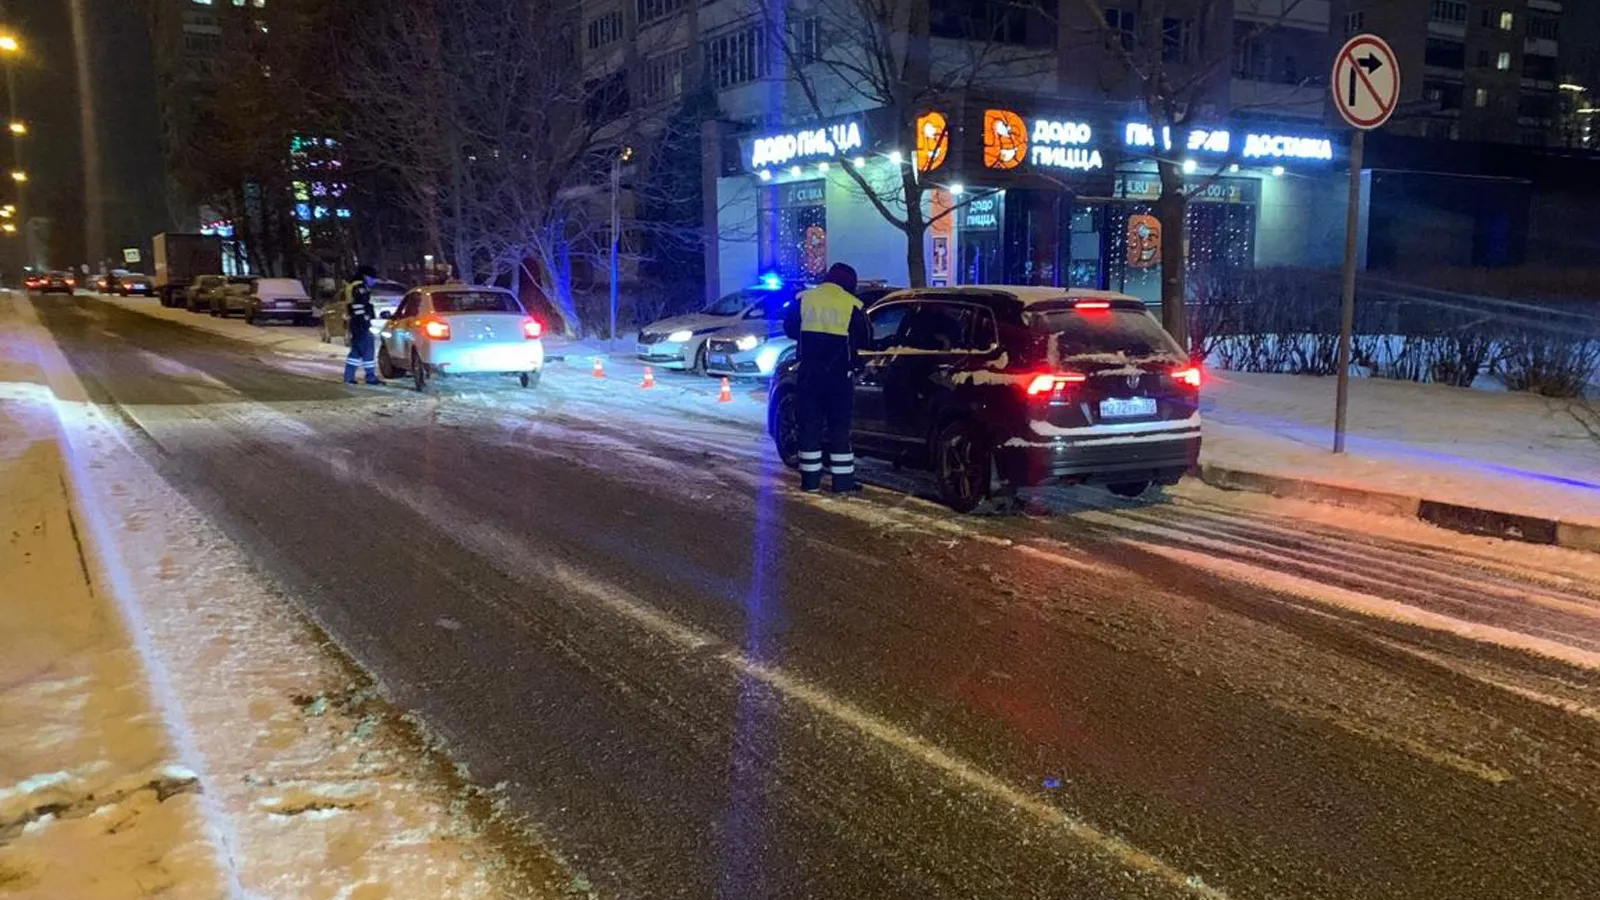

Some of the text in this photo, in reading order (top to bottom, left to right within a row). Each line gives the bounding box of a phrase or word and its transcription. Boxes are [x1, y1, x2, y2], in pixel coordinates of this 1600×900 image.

[1032, 119, 1092, 145] ДОДО
[752, 134, 797, 168] ДОДО
[1031, 145, 1103, 171] ПИЦЦА
[1243, 133, 1333, 160] ДОСТАВКА
[966, 213, 998, 227] ПИЦЦА
